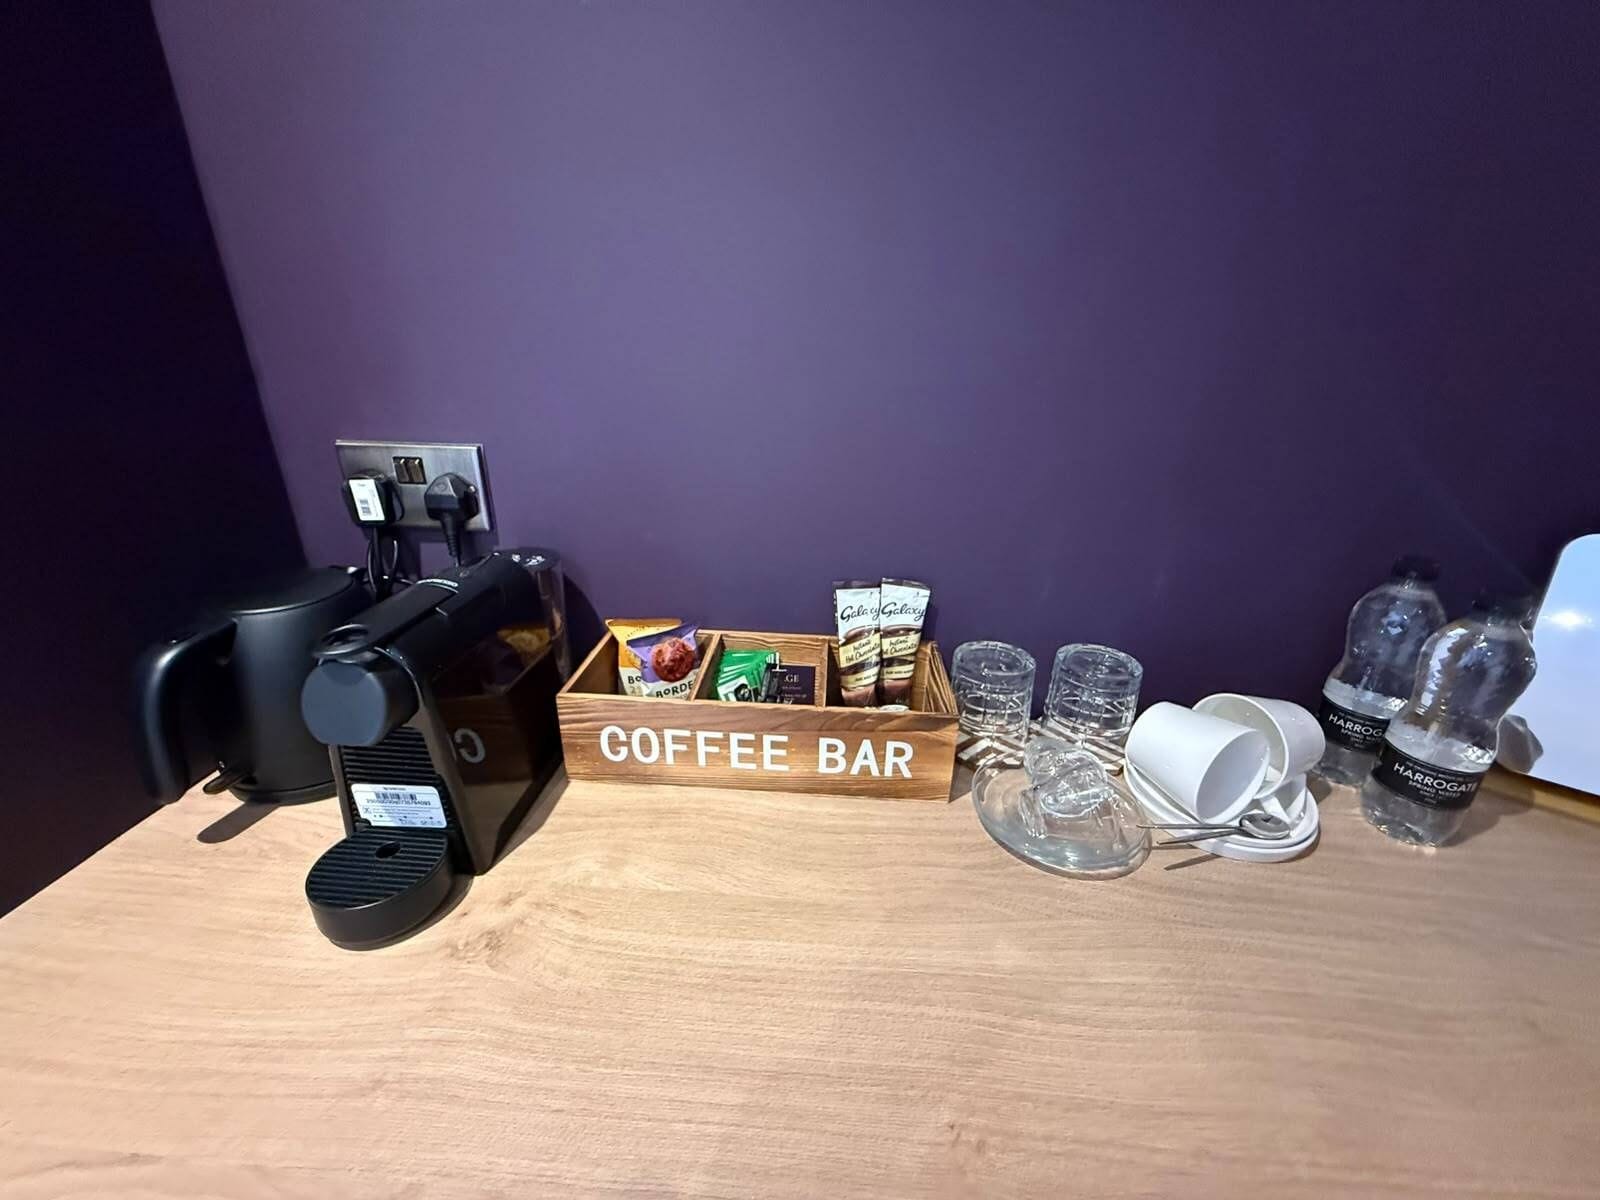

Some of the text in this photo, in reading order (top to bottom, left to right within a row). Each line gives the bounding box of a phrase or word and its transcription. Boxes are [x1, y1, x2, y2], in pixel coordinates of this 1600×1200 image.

[841, 605, 880, 622] Galaxy
[881, 602, 925, 621] Galaxy
[655, 681, 694, 699] BORDE
[1328, 713, 1384, 737] HARROG
[600, 725, 914, 778] COFFEE BAR
[1408, 780, 1436, 795] SPRING
